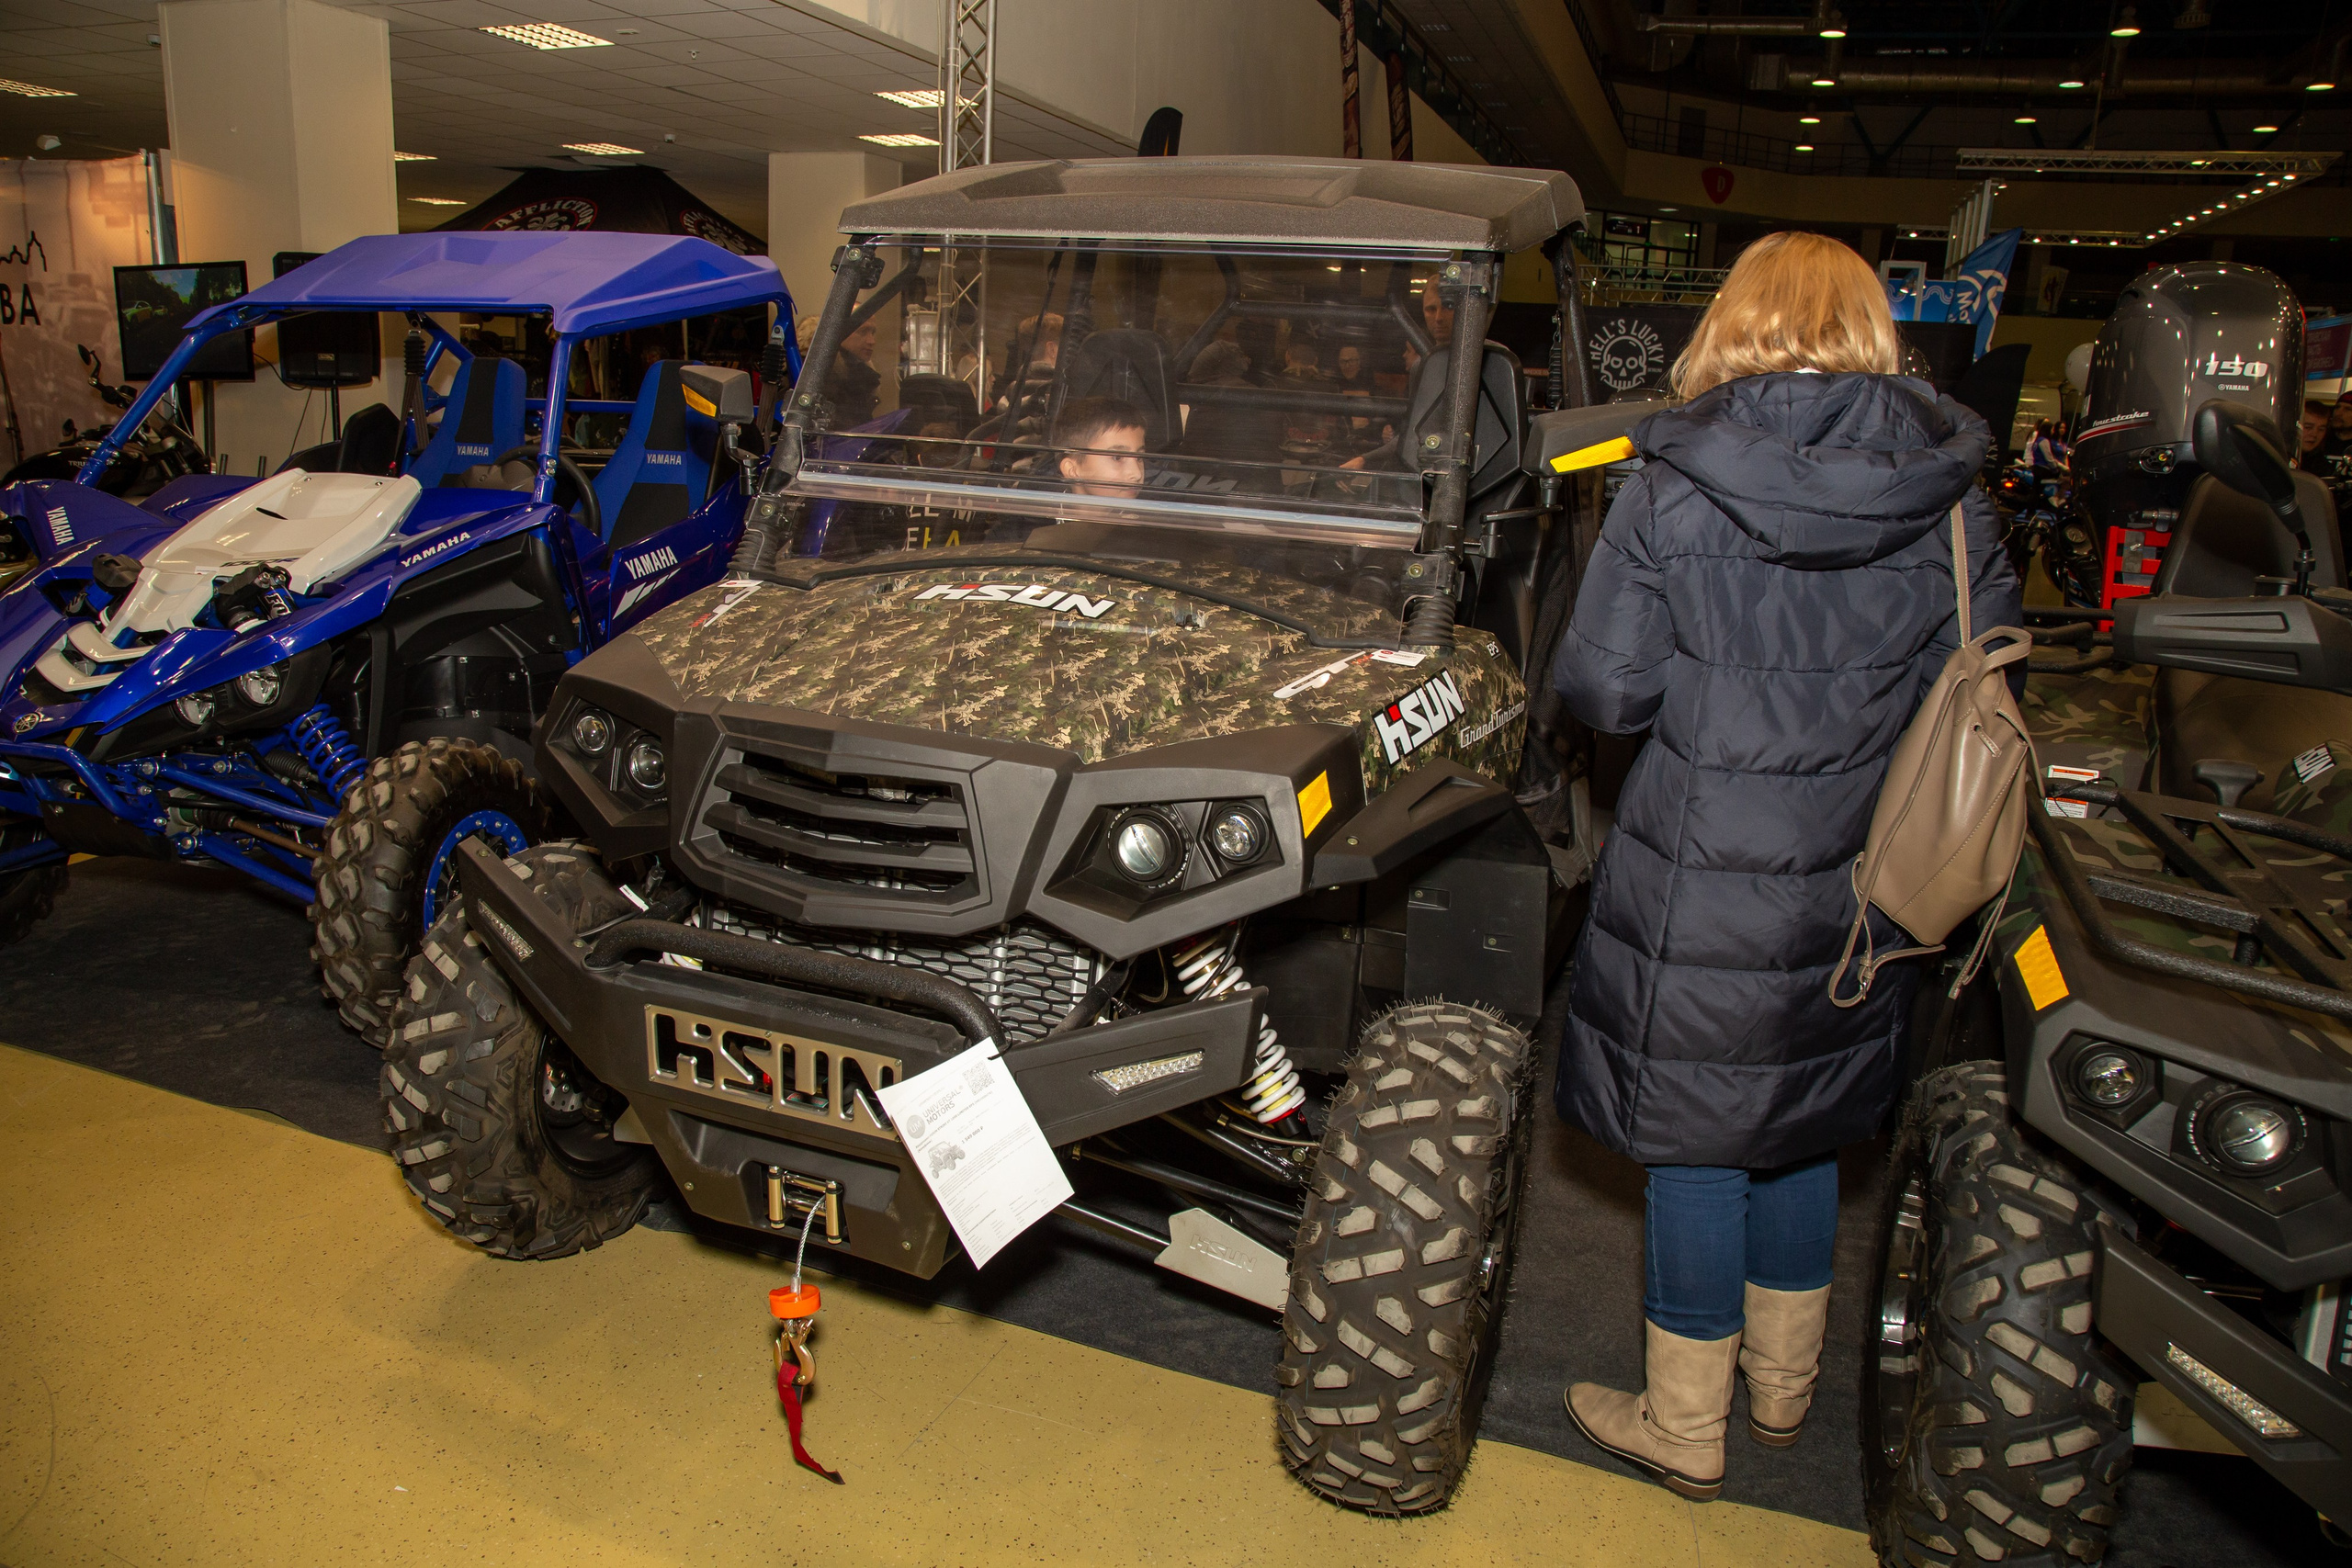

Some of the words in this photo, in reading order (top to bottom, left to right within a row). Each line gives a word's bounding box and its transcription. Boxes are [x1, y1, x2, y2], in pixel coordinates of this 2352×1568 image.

[494, 199, 594, 228] AFFLICTION
[1630, 320, 1665, 363] LUCKY
[2205, 360, 2268, 378] 150
[67, 460, 87, 468] TRIU
[457, 446, 490, 457] YAMAHA
[646, 453, 683, 466] YAMAHA
[47, 506, 75, 546] YAMAHA
[401, 532, 471, 568] YAMAHA
[625, 546, 679, 580] YAMAHA
[265, 592, 291, 619] FO
[1487, 641, 1500, 658] EPS
[922, 1089, 961, 1118] UNIVERSAL
[926, 1100, 956, 1125] MOTORS
[910, 1120, 922, 1134] UM
